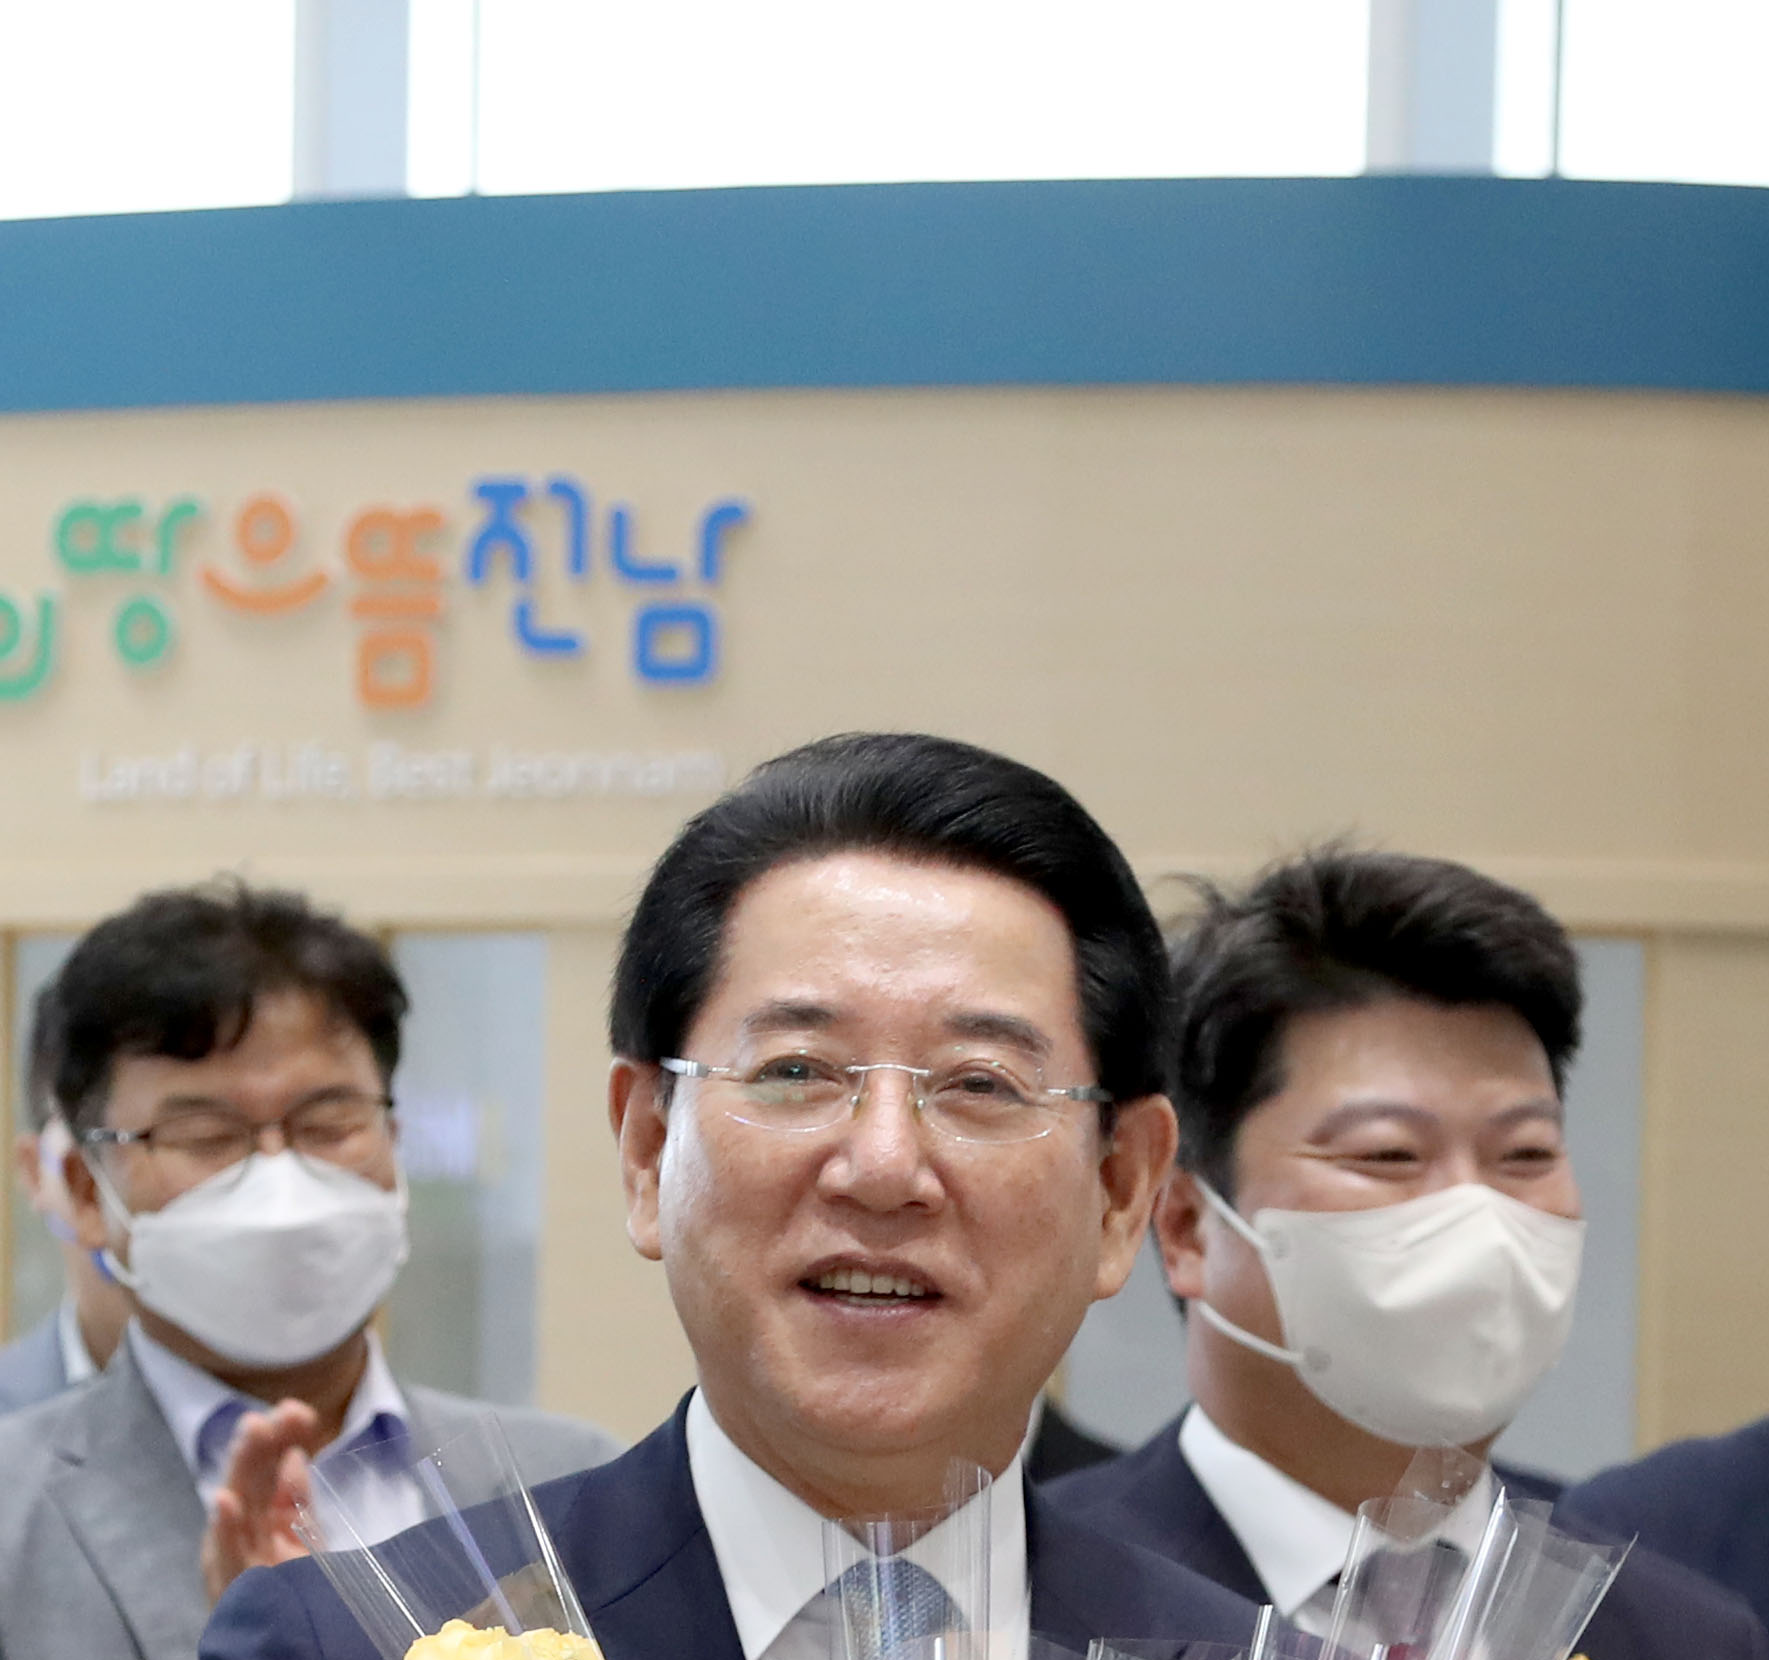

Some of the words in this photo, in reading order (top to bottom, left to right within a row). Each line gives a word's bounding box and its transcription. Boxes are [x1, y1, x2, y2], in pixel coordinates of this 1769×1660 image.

[54, 502, 199, 665] 땅
[78, 738, 201, 803] Land
[207, 738, 256, 800] of
[368, 738, 475, 799] Best
[485, 740, 723, 798] Jeonnam
